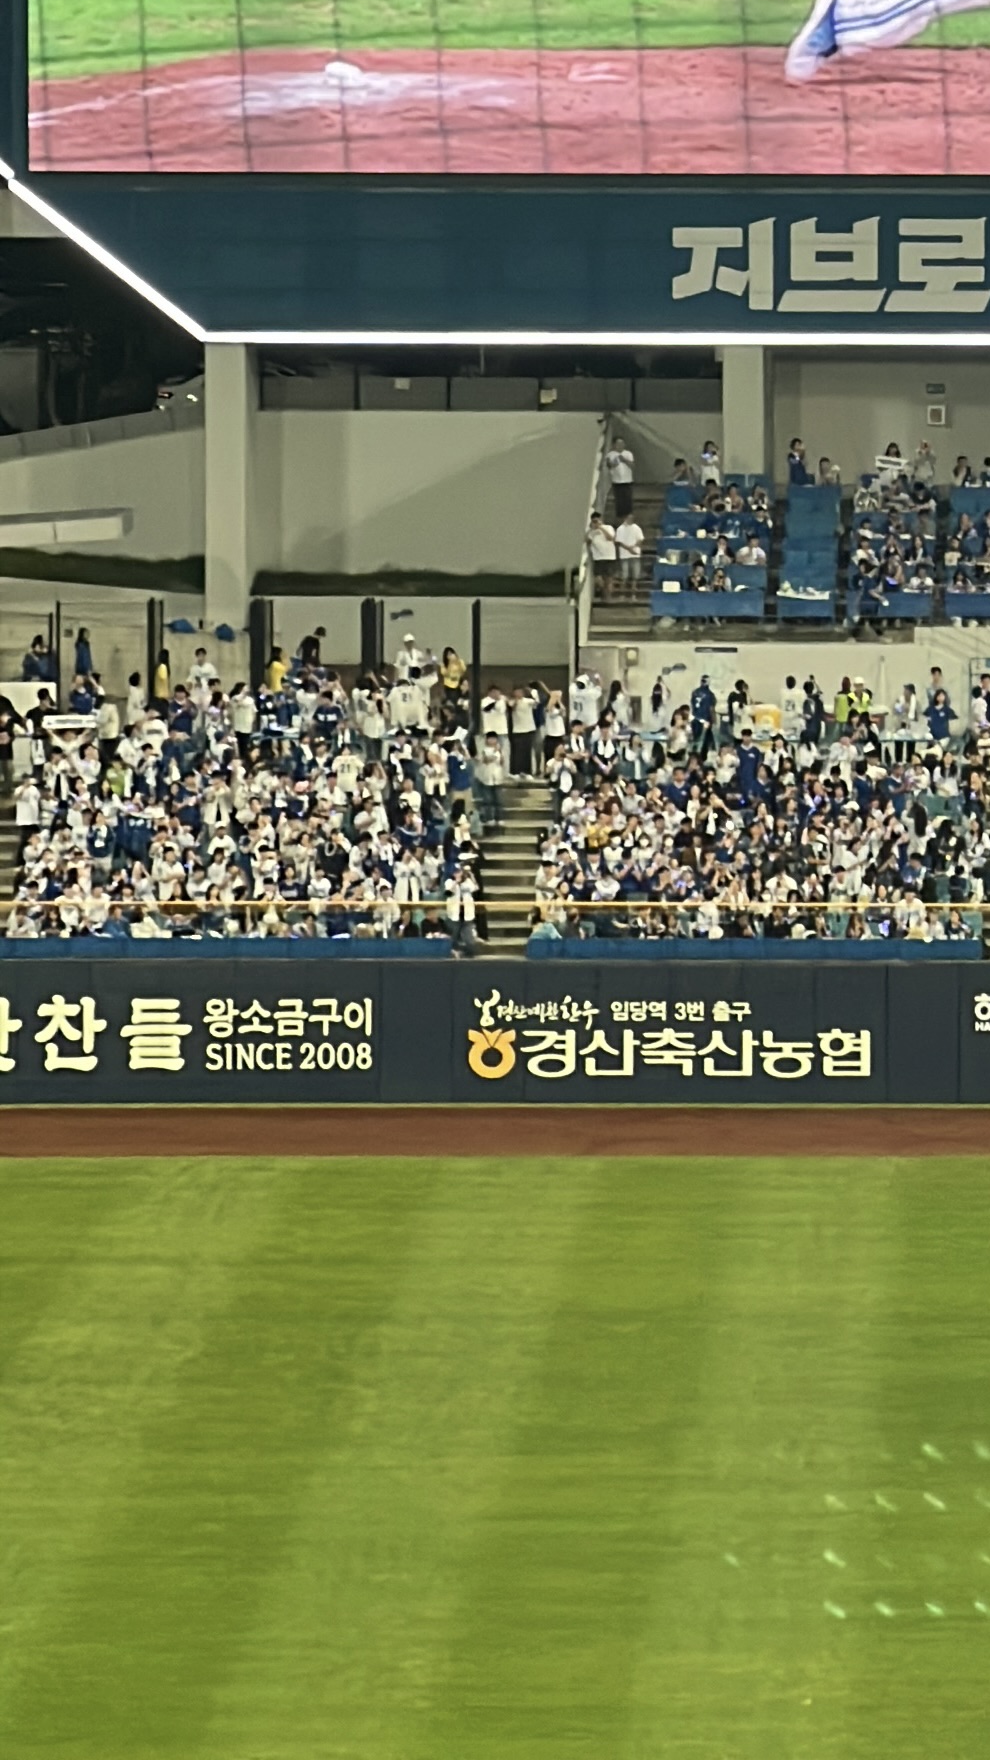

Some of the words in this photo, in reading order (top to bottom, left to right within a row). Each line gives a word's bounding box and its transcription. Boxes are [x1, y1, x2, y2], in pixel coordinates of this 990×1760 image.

[202, 997, 373, 1038] 왕소금구이
[610, 1000, 667, 1022] 임당역
[674, 1000, 705, 1022] 3번
[711, 1000, 752, 1022] 출구
[205, 1042, 293, 1071] SINCE
[299, 1042, 373, 1070] 2008
[520, 1028, 871, 1078] 경산축산농협
